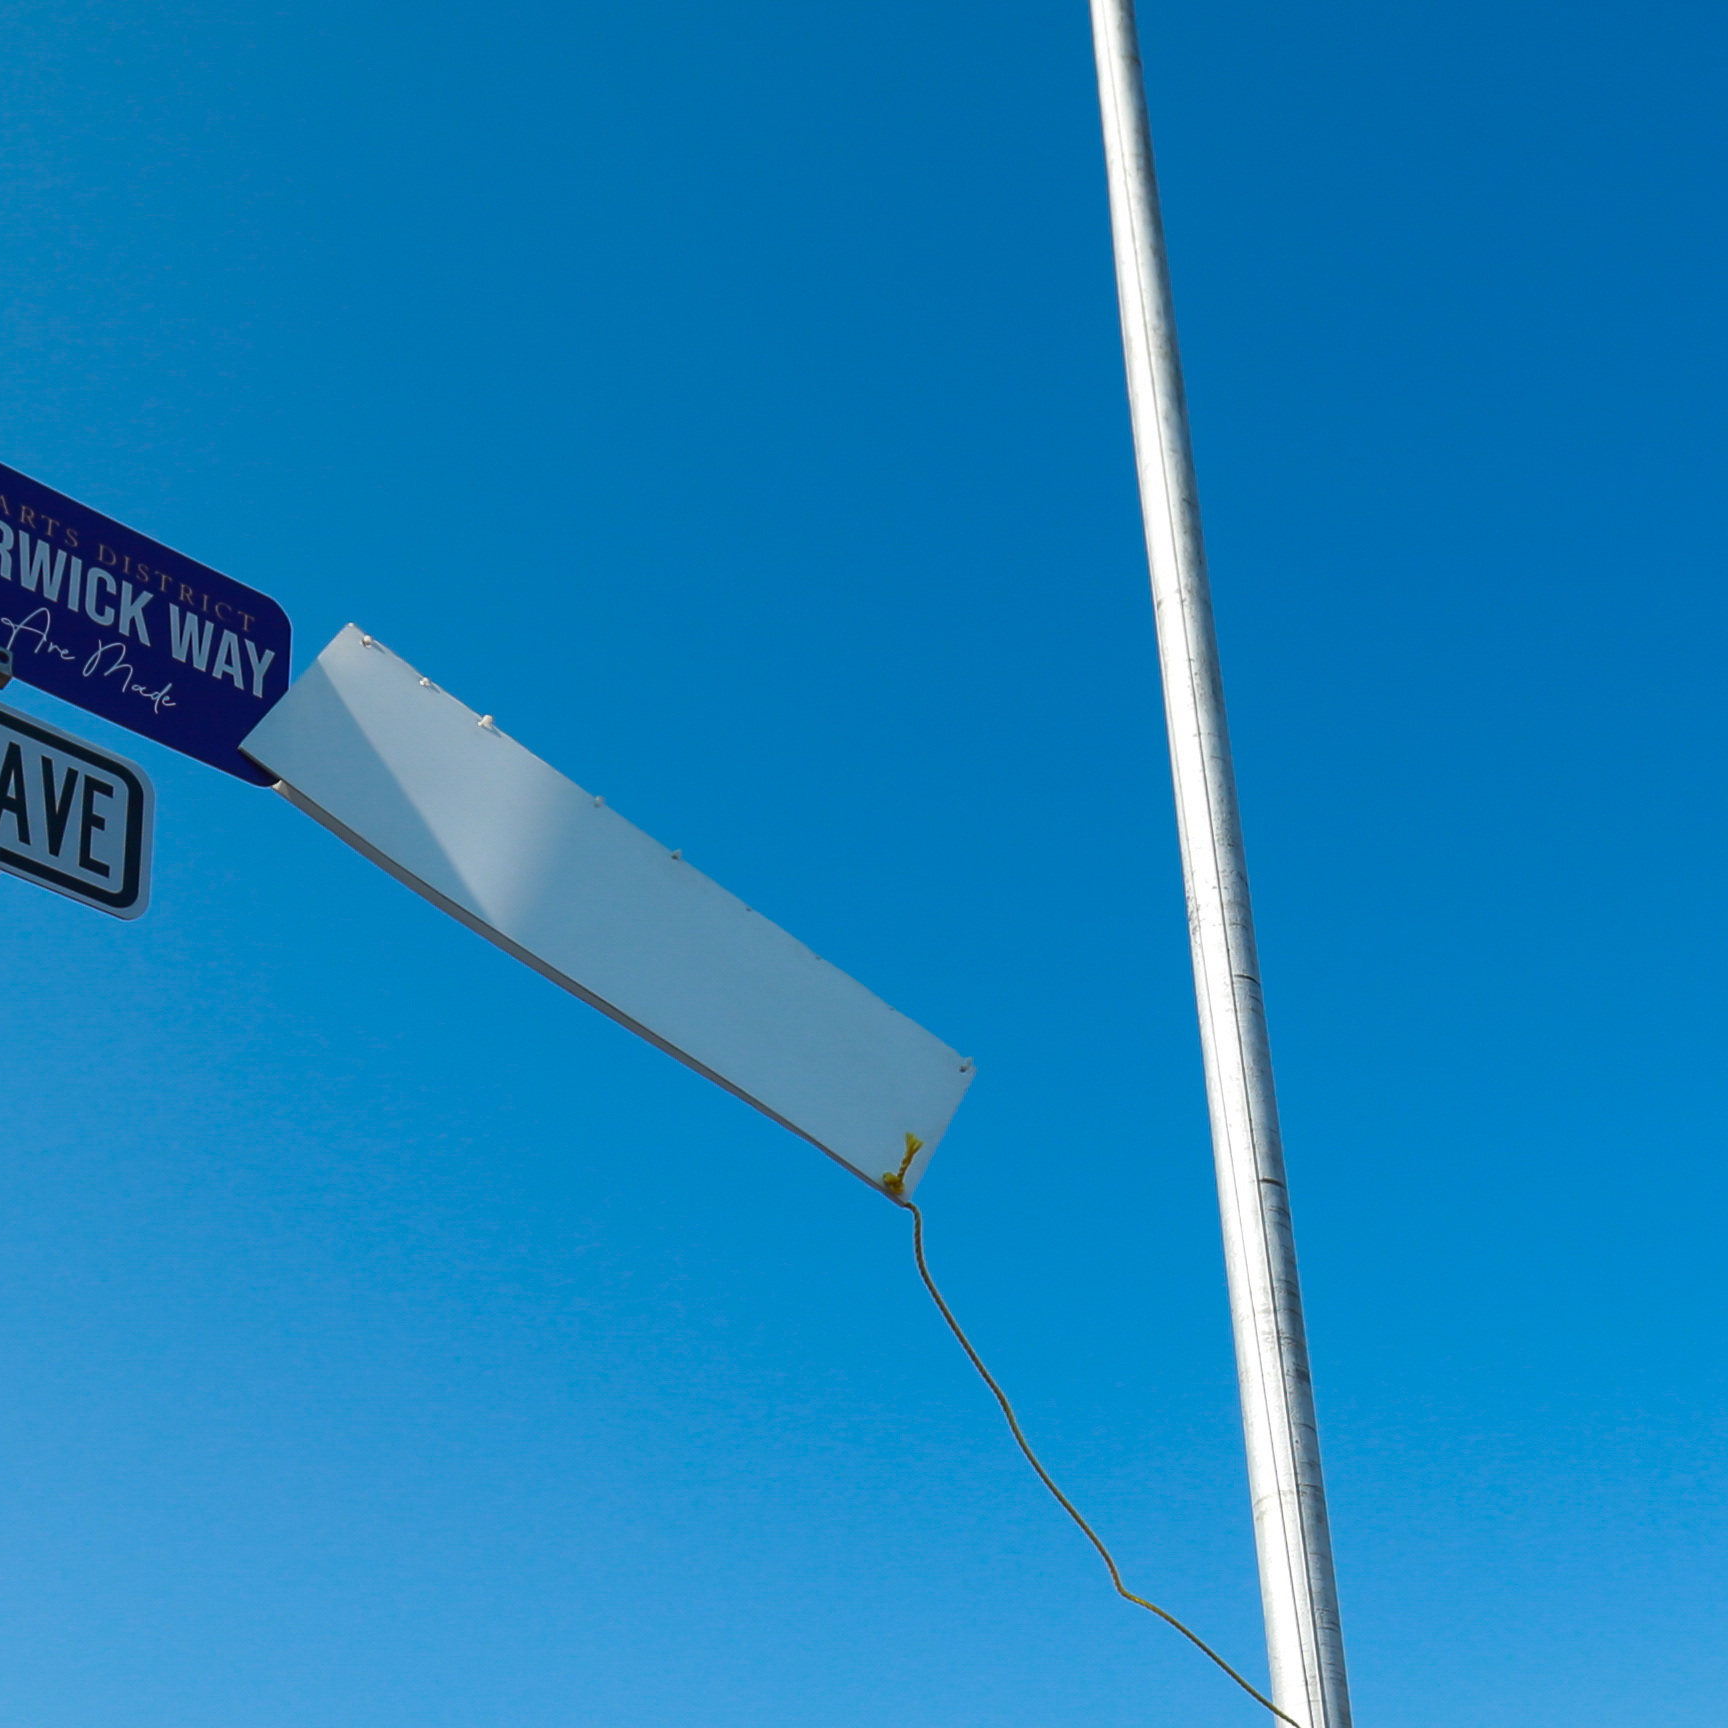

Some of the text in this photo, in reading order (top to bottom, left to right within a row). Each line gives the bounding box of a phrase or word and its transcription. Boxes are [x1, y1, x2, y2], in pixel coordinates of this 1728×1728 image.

[94, 543, 257, 633] DISTRICT
[83, 636, 178, 714] Made
[166, 598, 277, 702] WAY
